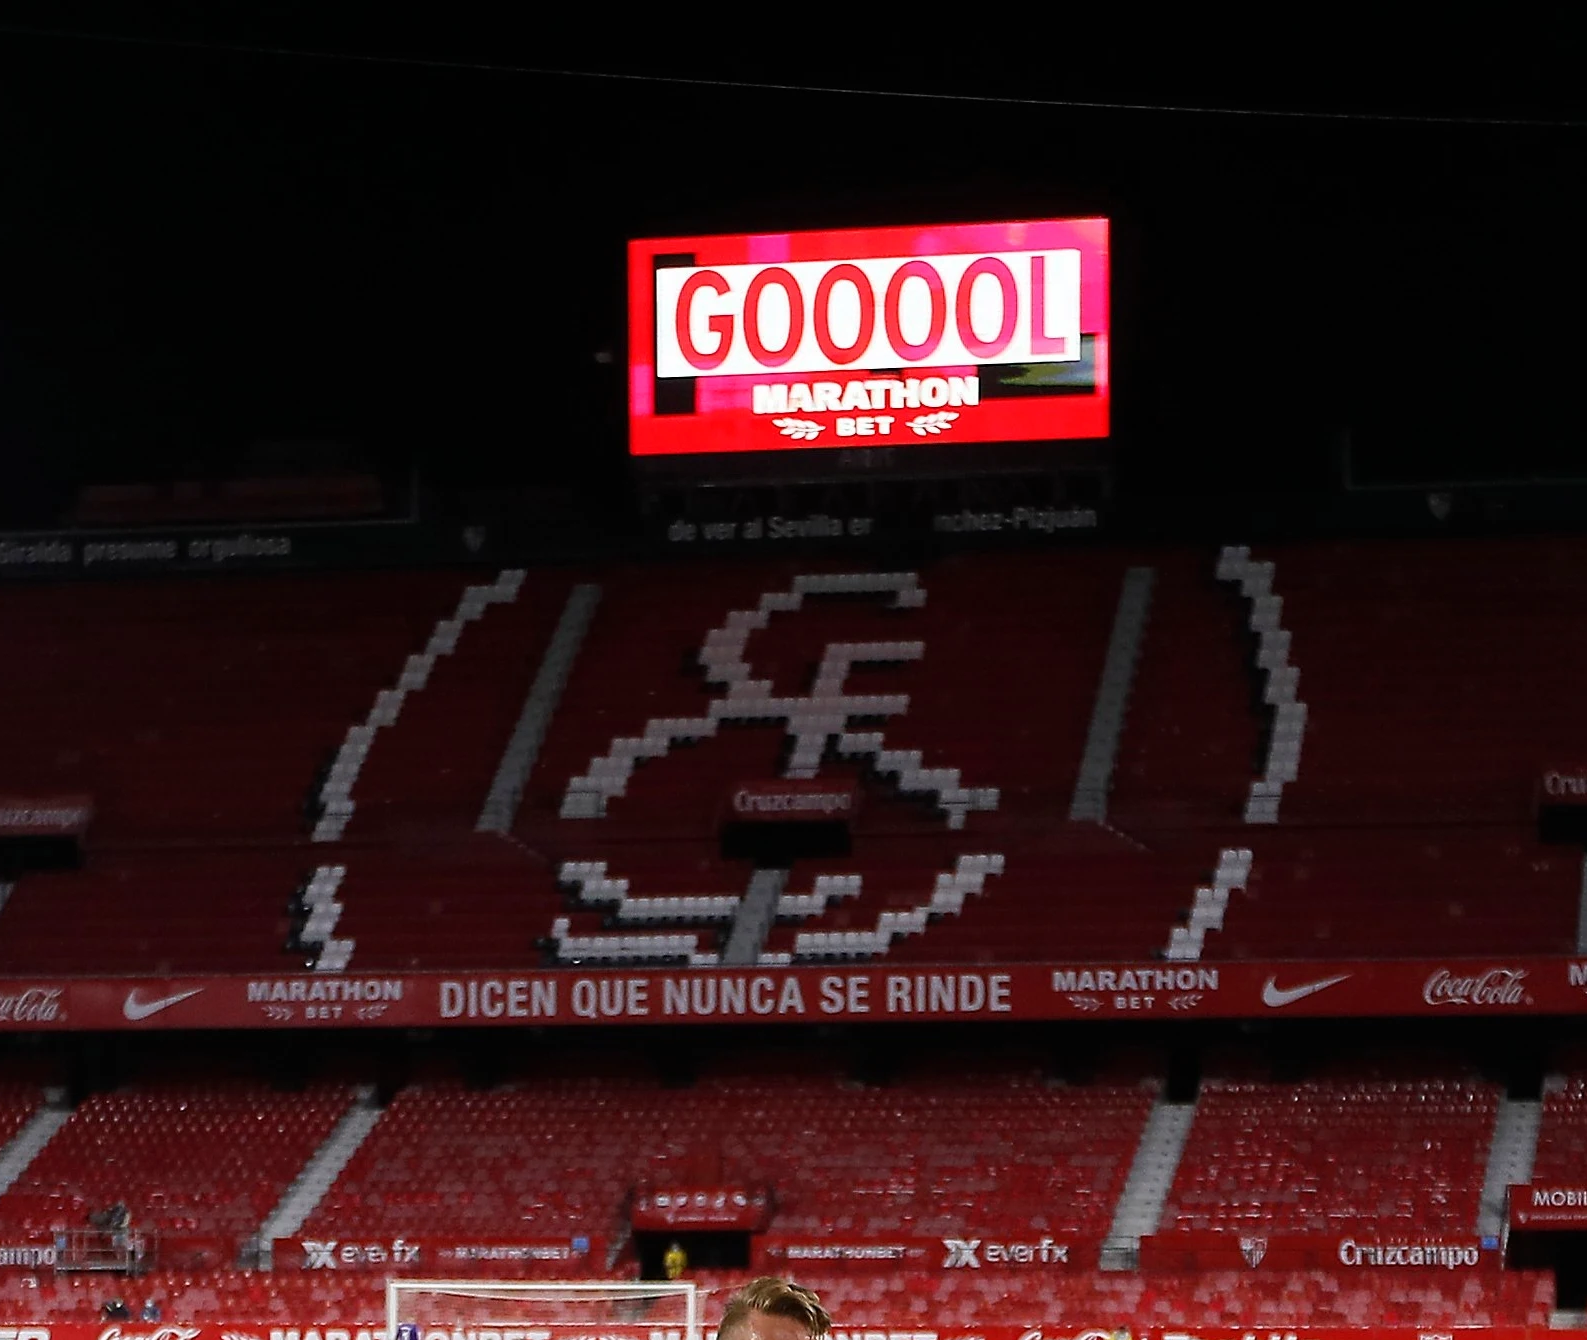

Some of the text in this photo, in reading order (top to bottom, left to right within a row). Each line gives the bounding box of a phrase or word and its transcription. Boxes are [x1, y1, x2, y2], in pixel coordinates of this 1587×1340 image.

[675, 256, 1066, 371] GOOOOL
[752, 376, 980, 415] MARATHON
[836, 415, 895, 437] BET
[248, 980, 404, 1003] MARATHON
[1051, 968, 1219, 993] MARATHON
[440, 973, 1012, 1019] DICEN QUE NUNCA SE RINDE
[1114, 995, 1156, 1010] BET
[305, 1006, 343, 1020] BET
[1339, 1239, 1479, 1268] Cruzcampo
